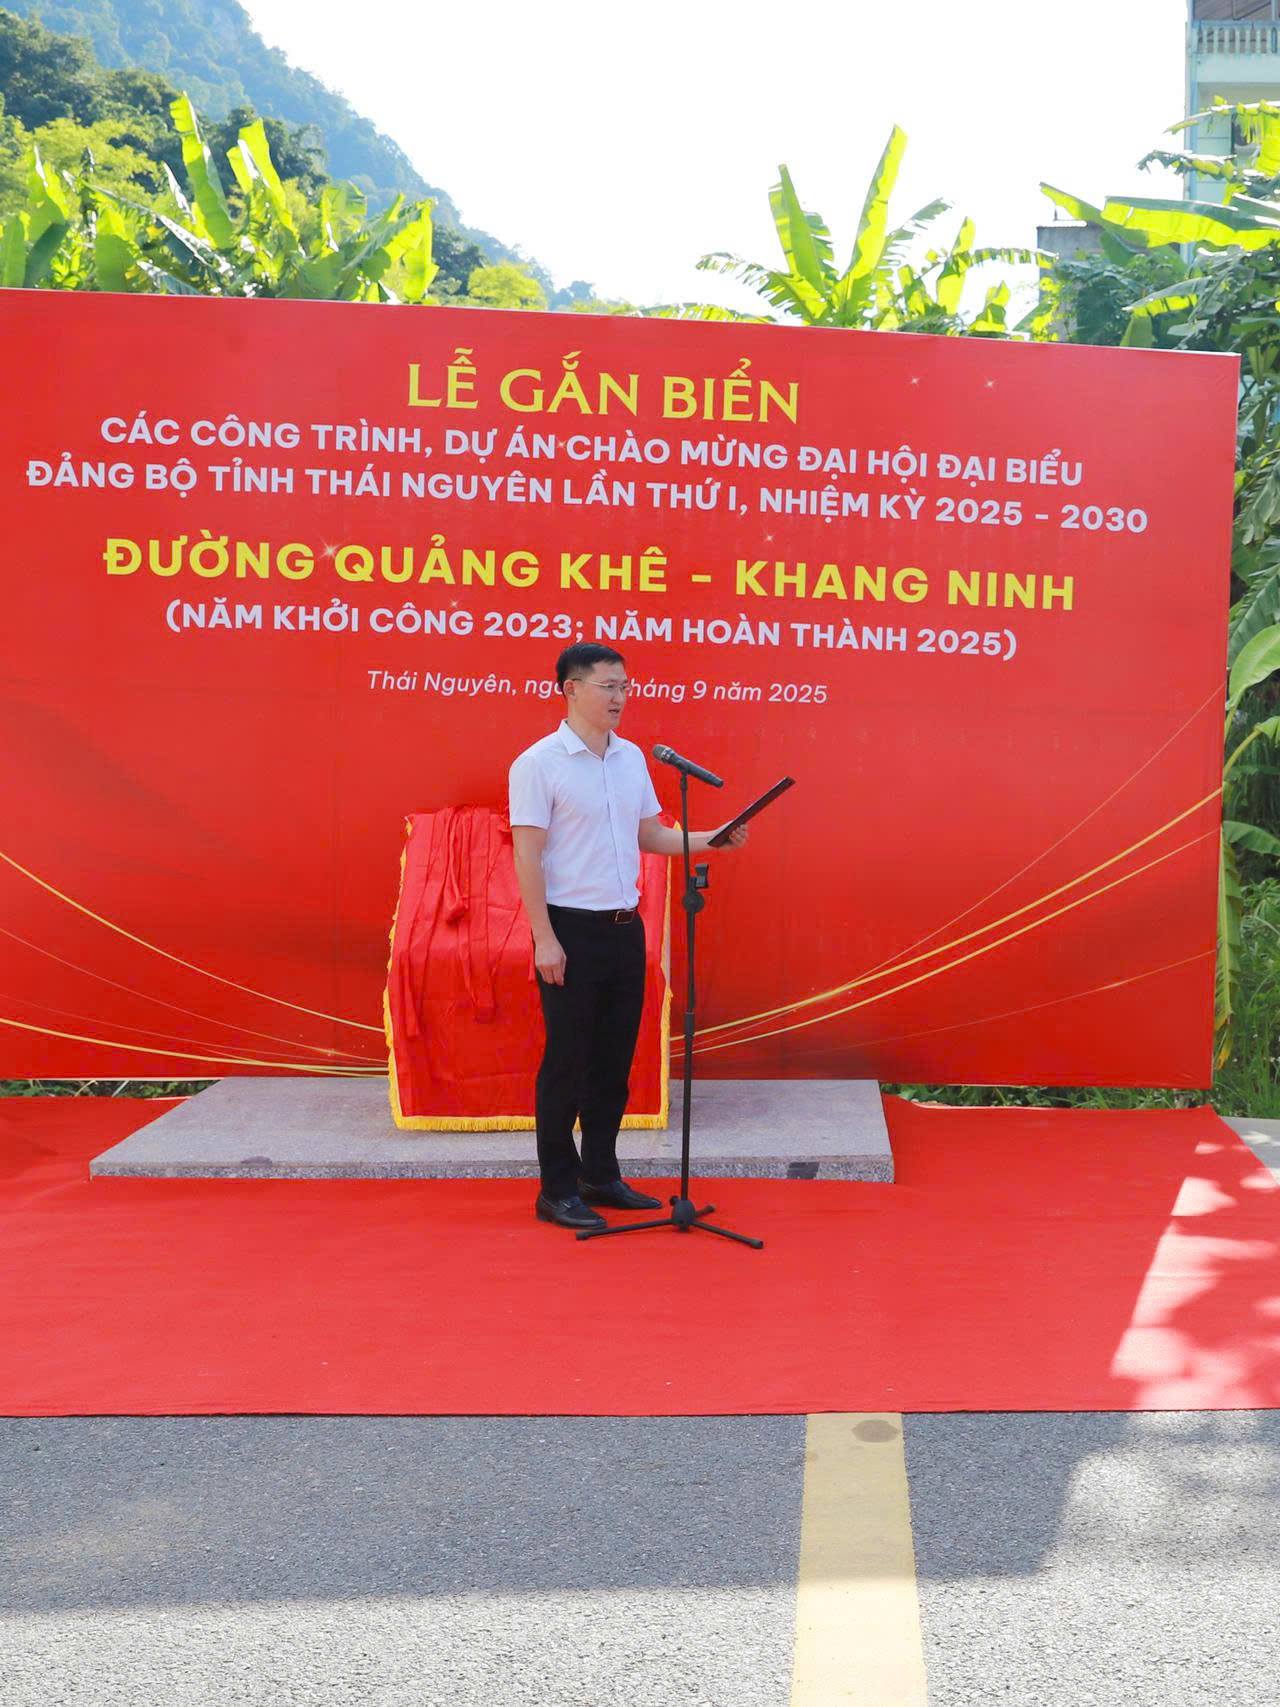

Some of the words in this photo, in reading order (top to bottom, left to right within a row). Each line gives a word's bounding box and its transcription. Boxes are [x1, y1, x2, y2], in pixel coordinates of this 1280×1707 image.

[407, 347, 479, 410] LỄ
[499, 350, 640, 417] GẮN
[661, 357, 799, 425] BIỂN
[100, 410, 180, 445] CÁC
[190, 413, 301, 449] CÔNG
[310, 418, 433, 458] TRÌNH,
[445, 428, 498, 464] DỰ
[504, 424, 556, 459] ÁN
[566, 429, 671, 464] CHÀO
[680, 433, 788, 470] MỪNG
[798, 445, 857, 480] ĐẠI
[867, 444, 928, 484] HỘI
[936, 453, 996, 488] ĐẠI
[1005, 448, 1083, 487] BIỂU
[25, 451, 135, 489] ĐẢNG
[145, 457, 198, 498] BỘ
[207, 456, 294, 494] TỈNH
[304, 463, 391, 497] THÁI
[402, 470, 552, 504] NGUYÊN
[563, 468, 636, 507] LẦN
[645, 477, 722, 510] THỨ
[728, 485, 748, 516] I,
[759, 484, 869, 524] NHIỆM
[879, 487, 926, 520] KỲ
[935, 496, 1023, 526] 2025
[1060, 504, 1148, 534] 2030
[102, 529, 315, 580] ĐƯỜNG
[335, 534, 539, 587] QUẢNG
[560, 546, 668, 593] KHÊ
[735, 559, 929, 603] KHANG
[947, 569, 1074, 611] NINH
[166, 596, 263, 633] (NĂM
[273, 597, 359, 632] KHỞI
[369, 601, 474, 636] CÔNG
[483, 611, 584, 643] 2023;
[595, 609, 672, 642] NĂM
[683, 613, 780, 646] HOÀN
[790, 617, 907, 652] THÀNH
[916, 628, 1017, 661] 2025)
[367, 670, 417, 691] Thái
[423, 672, 517, 697] Nguyên,
[627, 678, 685, 703] háng
[692, 680, 707, 700] 9
[713, 681, 762, 701] năm
[768, 683, 827, 704] 2025
